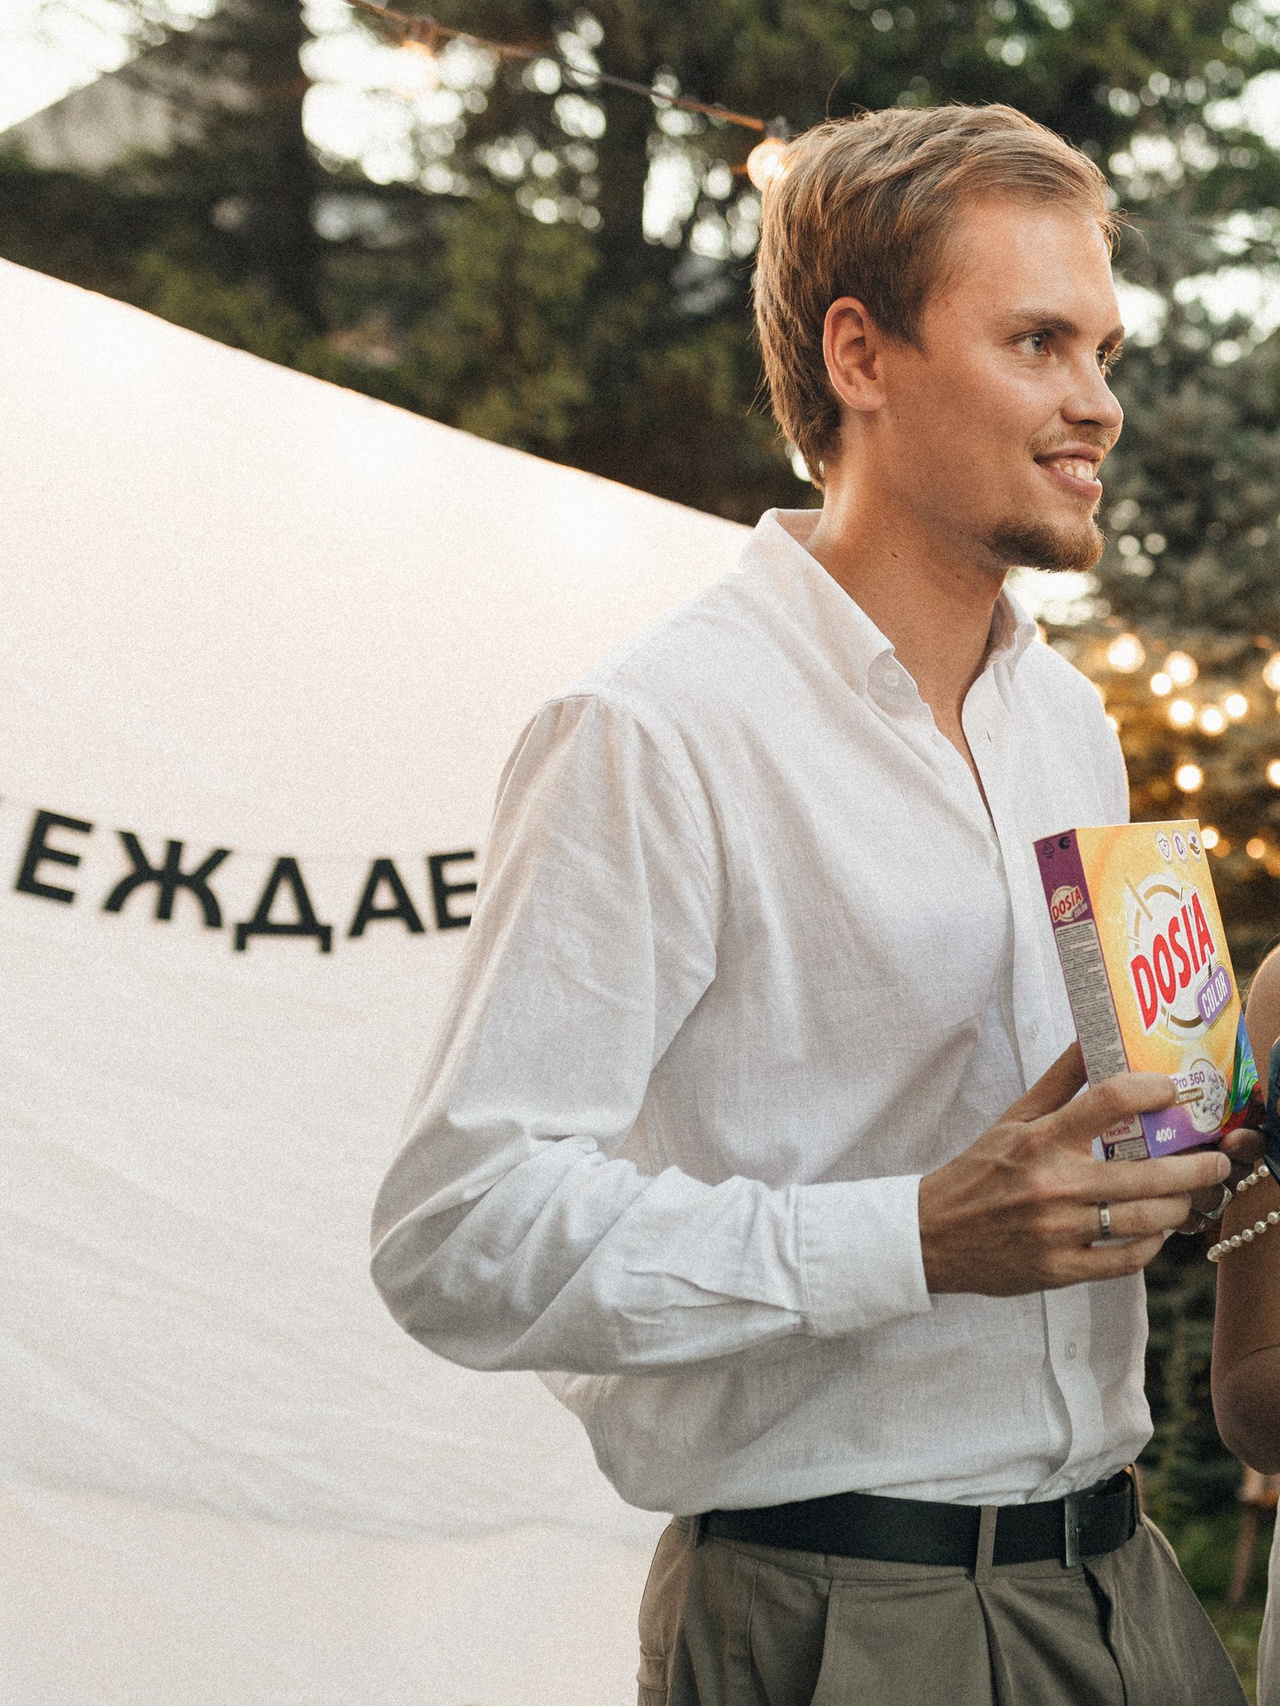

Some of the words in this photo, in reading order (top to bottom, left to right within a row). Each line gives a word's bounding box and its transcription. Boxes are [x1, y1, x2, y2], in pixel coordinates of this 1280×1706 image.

[1051, 887, 1082, 921] DOSIA
[1130, 892, 1215, 1031] DOSIA
[1201, 971, 1228, 1018] COLOR
[1189, 1071, 1206, 1086] 360
